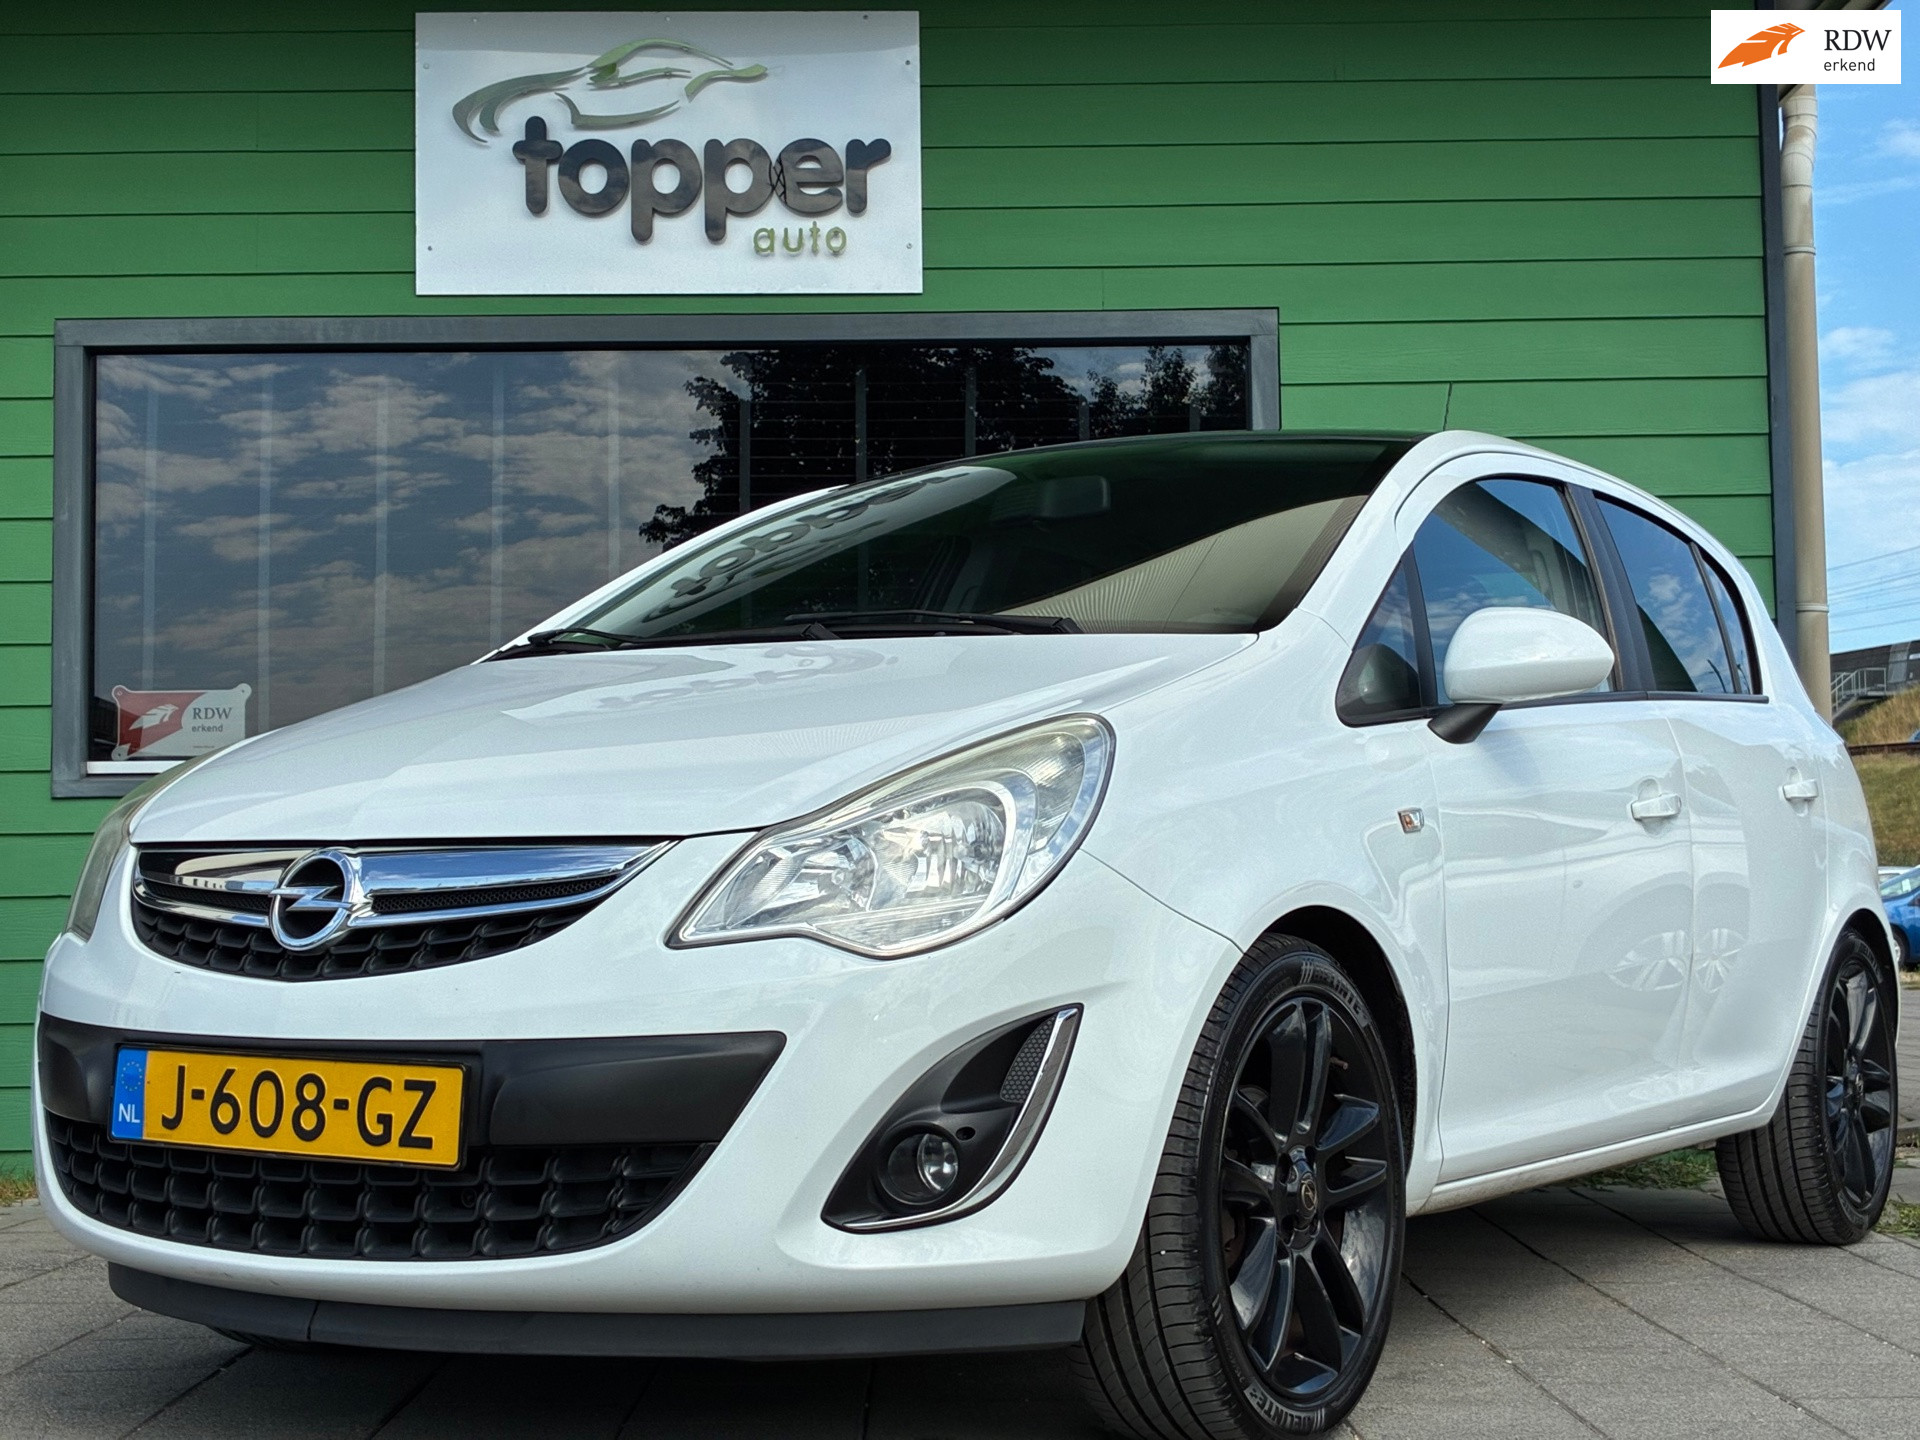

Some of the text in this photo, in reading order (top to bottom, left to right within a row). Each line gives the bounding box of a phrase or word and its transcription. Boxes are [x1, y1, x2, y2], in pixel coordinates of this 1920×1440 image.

[512, 116, 891, 242] topper
[753, 221, 847, 255] auto
[192, 707, 232, 720] RDW
[192, 724, 223, 733] erkend
[118, 1103, 141, 1124] NL
[161, 1065, 437, 1150] J-608-GZ
